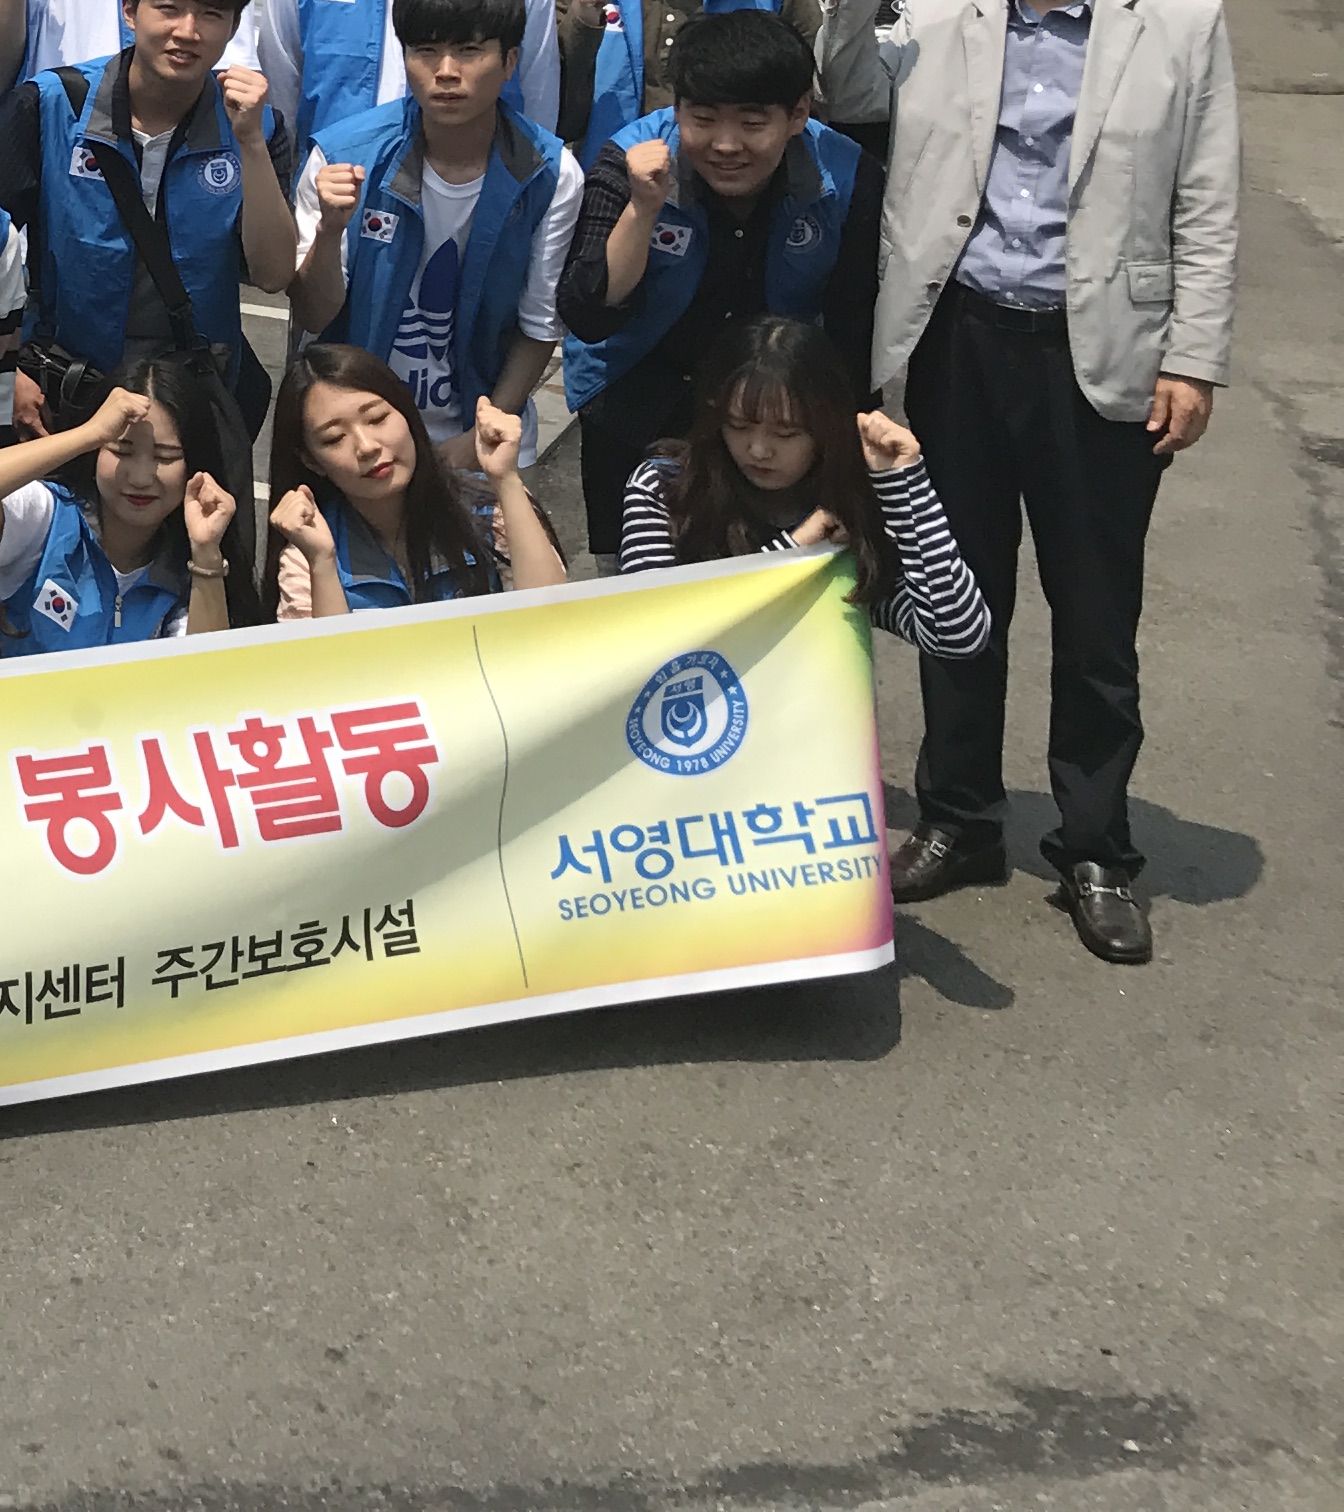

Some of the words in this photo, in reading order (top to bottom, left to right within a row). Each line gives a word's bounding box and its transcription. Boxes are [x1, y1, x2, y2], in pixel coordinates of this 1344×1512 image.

[629, 717, 671, 768] SEOYEONG
[676, 756, 710, 772] 1978
[709, 700, 745, 763] UNIVERSITY
[15, 700, 439, 876] 봉사활동
[550, 792, 880, 884] 서영대학교
[558, 876, 717, 921] SEOYEONG
[726, 852, 883, 896] UNIVERSITY
[150, 897, 421, 1001] 주간보호시설
